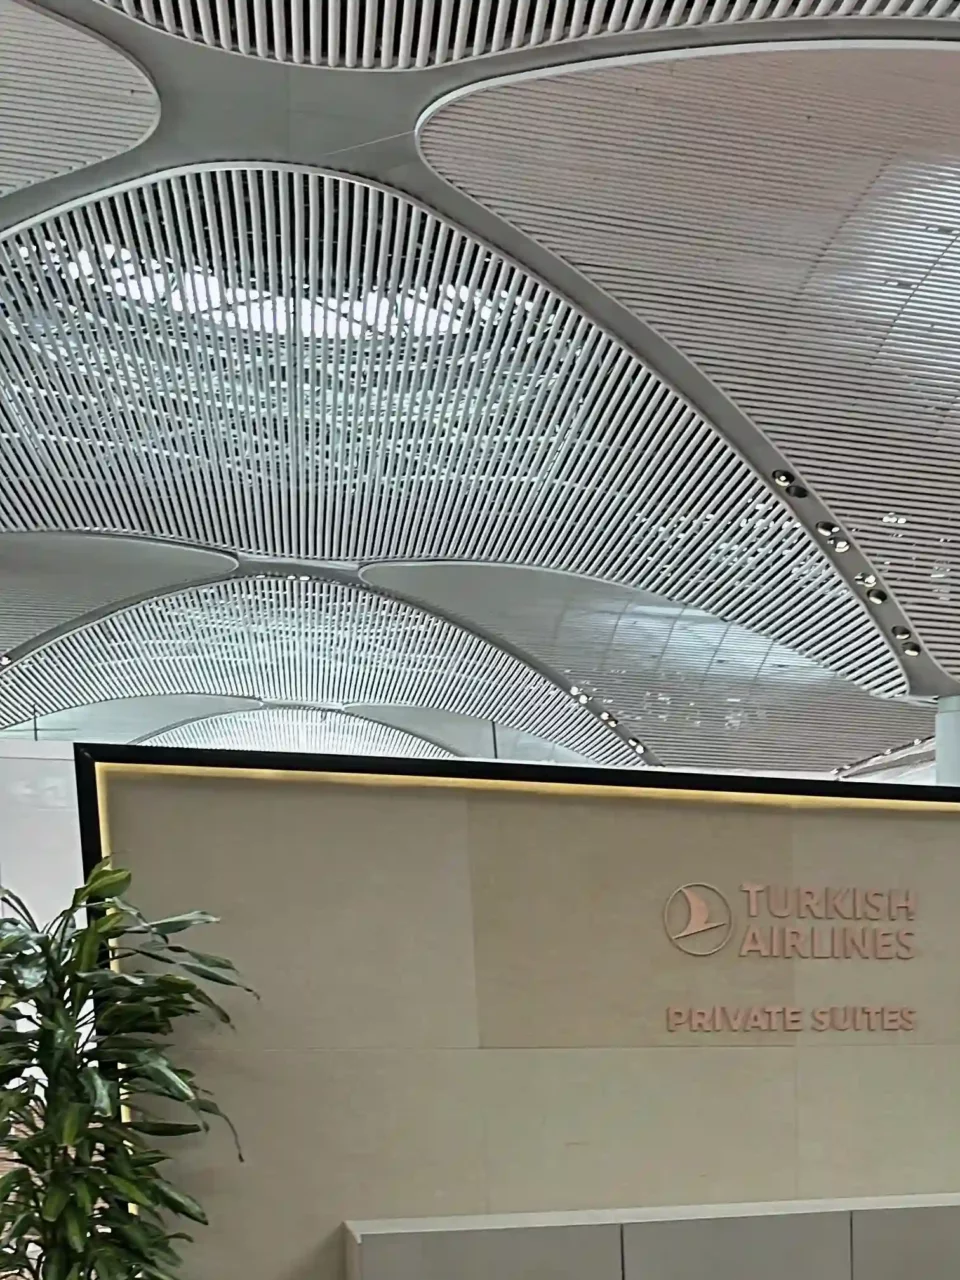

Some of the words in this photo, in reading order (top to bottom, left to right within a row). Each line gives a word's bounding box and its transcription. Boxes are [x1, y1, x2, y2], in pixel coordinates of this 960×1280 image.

[740, 883, 917, 920] TURKISH
[739, 926, 916, 960] AIRLINES
[665, 1005, 803, 1032] PRIVATE
[810, 1005, 917, 1032] SUITES
